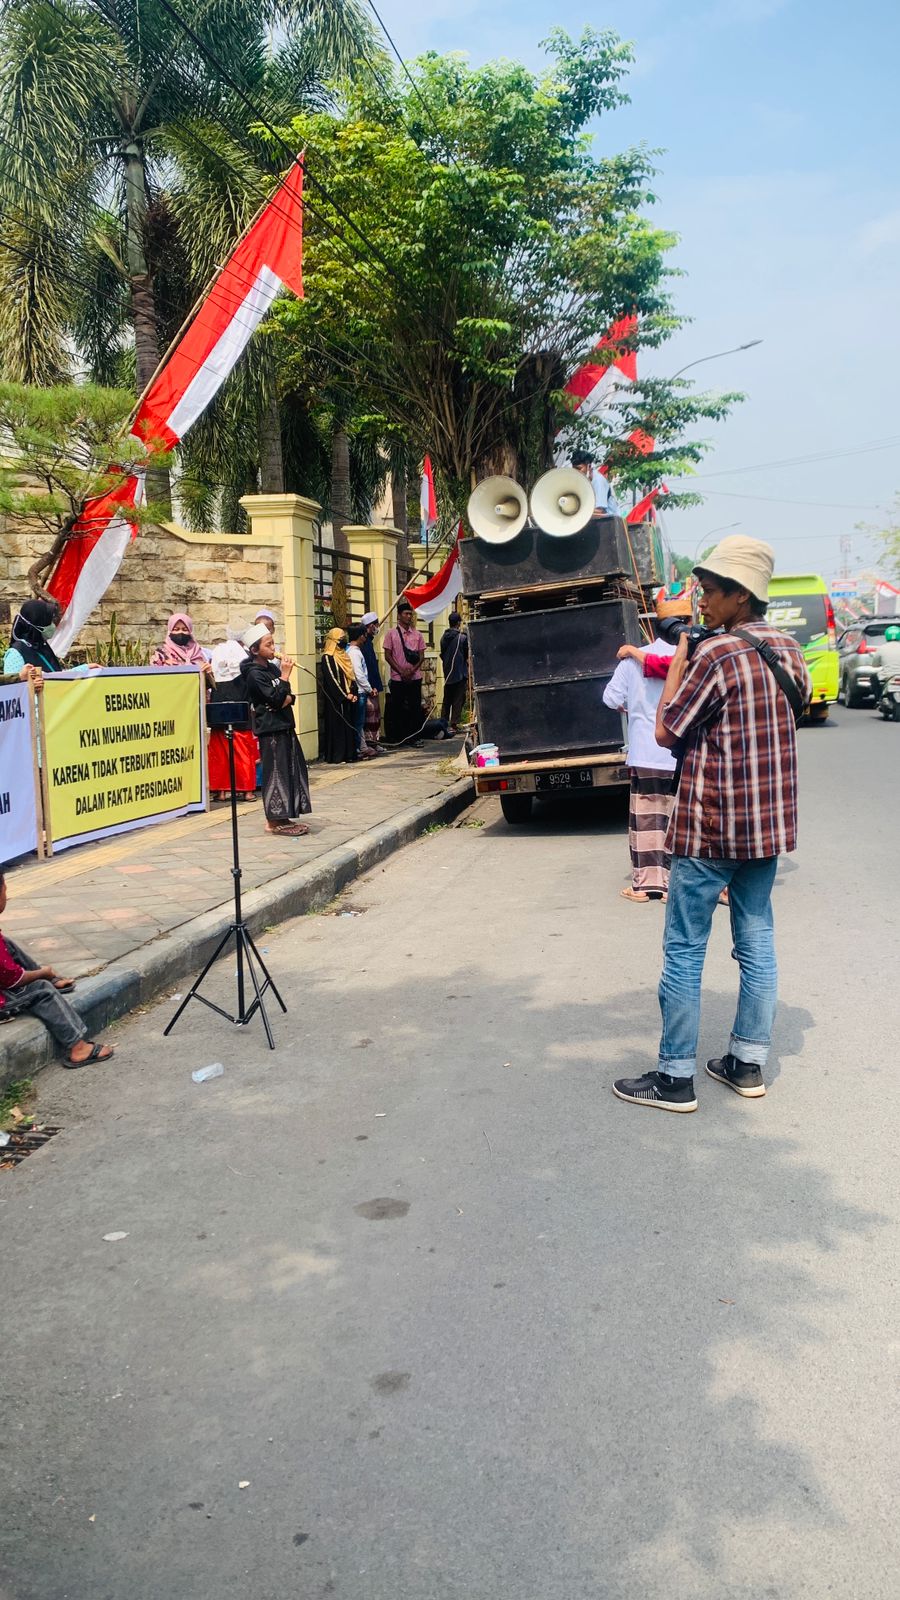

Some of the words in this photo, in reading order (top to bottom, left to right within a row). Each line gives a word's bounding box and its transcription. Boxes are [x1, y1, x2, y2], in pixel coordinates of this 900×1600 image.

[105, 692, 150, 712] BEBASKAN
[79, 728, 100, 748] KYAI
[102, 722, 151, 745] MUHAMMAD
[153, 719, 175, 738] FAHIM
[52, 763, 90, 787] KARENA
[92, 758, 118, 778] TIDAK
[120, 751, 159, 774] TERBUKTI
[535, 775, 541, 786] P
[549, 772, 570, 785] 9529
[75, 792, 105, 815] DALAM
[107, 786, 133, 808] FAKTA
[135, 776, 183, 801] PERSIDAGAN
